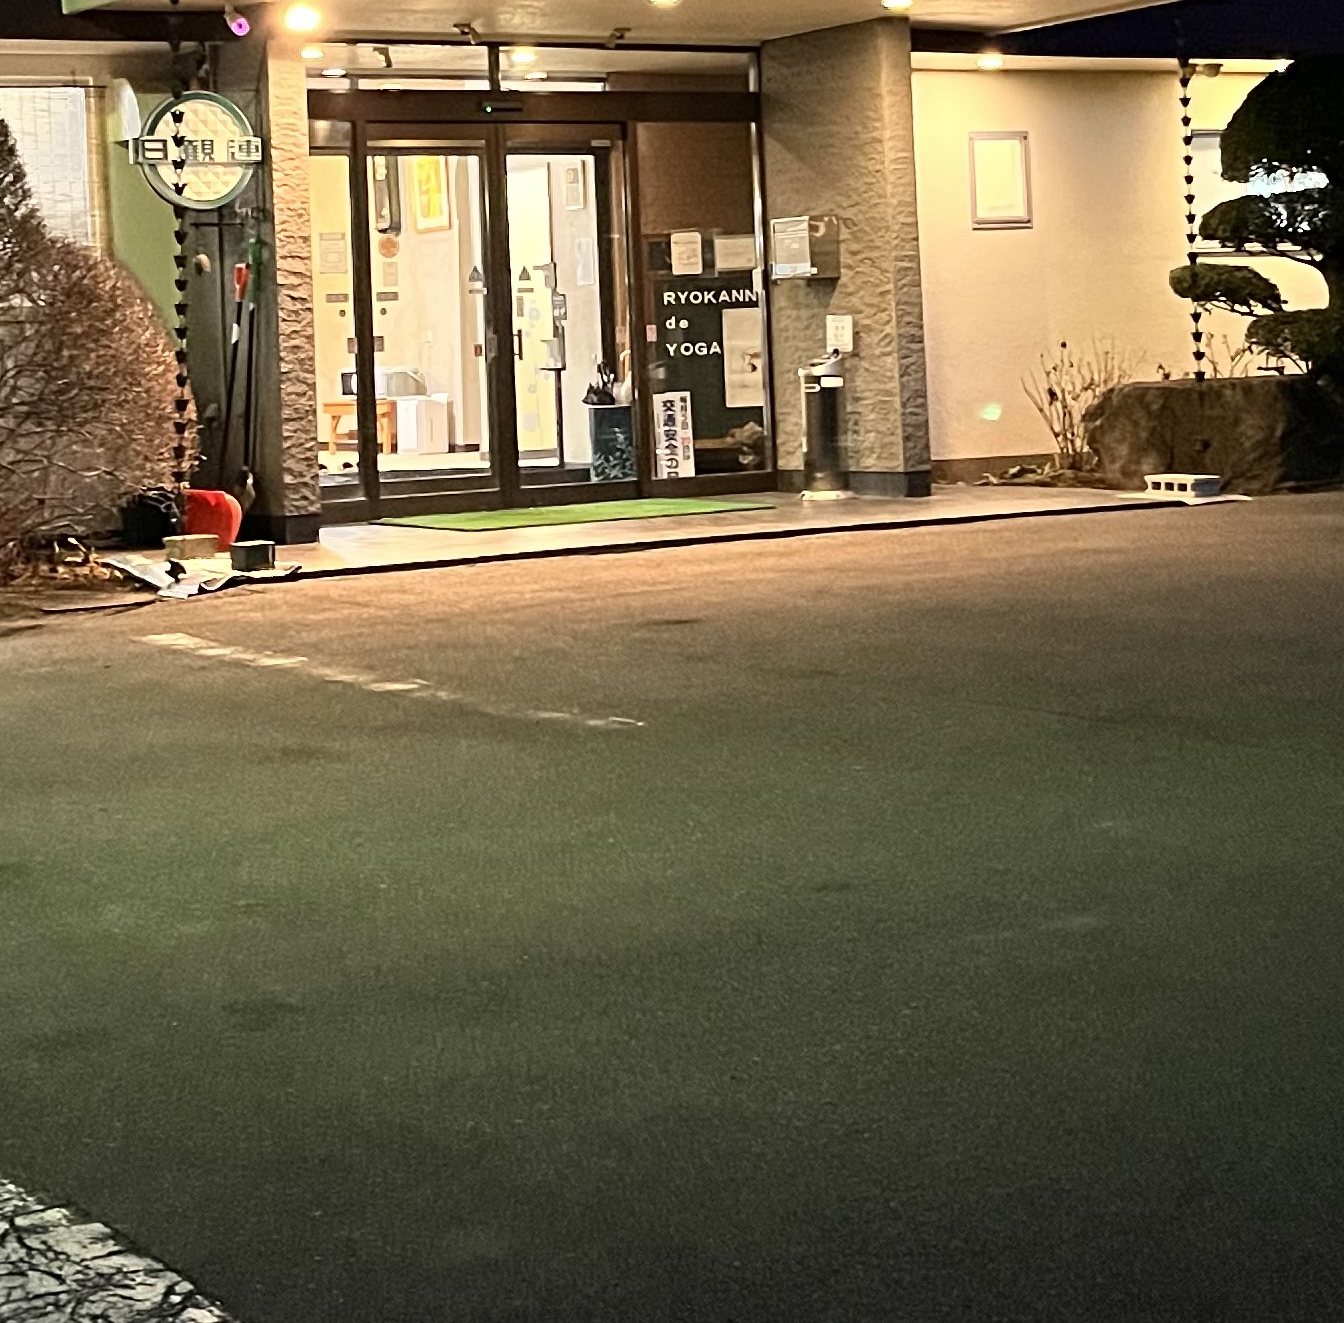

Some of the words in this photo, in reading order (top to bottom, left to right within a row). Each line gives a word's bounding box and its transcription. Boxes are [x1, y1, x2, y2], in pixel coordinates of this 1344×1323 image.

[663, 289, 757, 306] RYOKANN
[665, 315, 689, 329] de
[665, 341, 722, 357] YOGA
